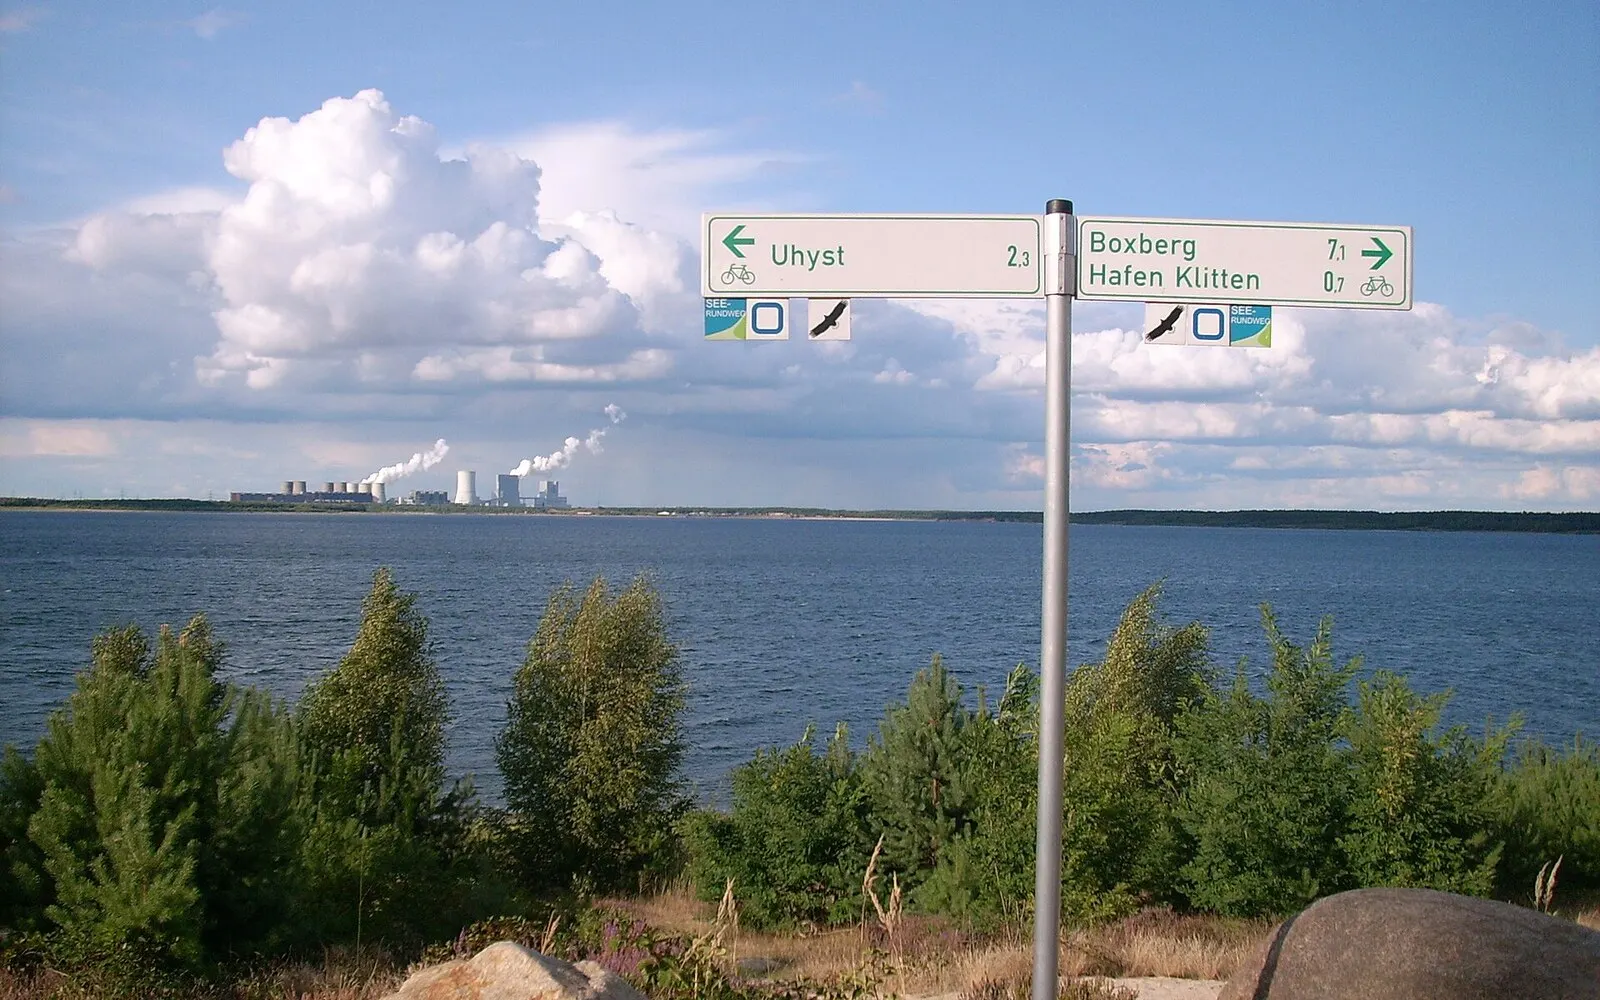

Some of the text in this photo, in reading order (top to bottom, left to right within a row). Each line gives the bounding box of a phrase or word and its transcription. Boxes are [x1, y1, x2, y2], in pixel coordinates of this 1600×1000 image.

[772, 244, 845, 271] Uhyst
[1007, 245, 1030, 269] 2,3
[1090, 232, 1196, 261] Boxberg
[1327, 239, 1346, 261] 7,1
[1090, 264, 1260, 290] Hafen Klitten
[1323, 271, 1344, 293] 0,7
[706, 299, 730, 308] SEE-
[1231, 306, 1256, 315] SEE-
[1231, 316, 1270, 324] RUNDWEG
